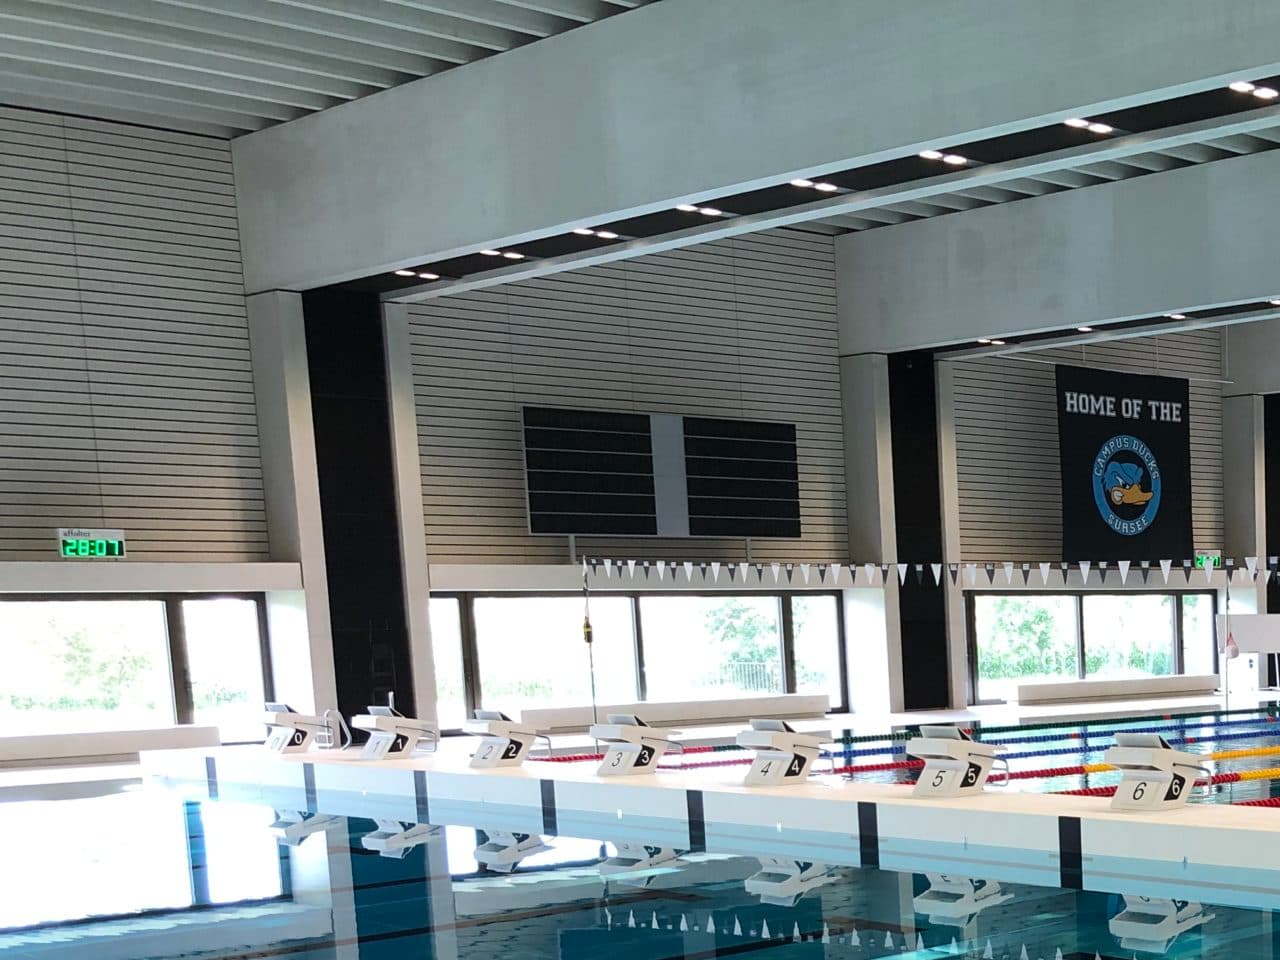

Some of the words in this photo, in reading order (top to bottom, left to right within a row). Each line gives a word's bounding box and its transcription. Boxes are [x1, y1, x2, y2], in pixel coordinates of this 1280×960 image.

[1065, 391, 1116, 417] HOME
[1121, 398, 1143, 419] OF
[1148, 401, 1182, 422] THE
[1094, 437, 1130, 477] CAMPUS
[1131, 439, 1160, 480] DUCKS
[1107, 514, 1148, 534] SURSEE
[65, 539, 119, 556] 28:07
[294, 732, 303, 745] 0
[397, 738, 404, 749] 1
[481, 745, 494, 760] 2
[507, 744, 517, 757] 2
[641, 750, 650, 764] 3
[611, 752, 623, 767] 3
[791, 759, 800, 773] 4
[760, 760, 772, 777] 4
[967, 768, 976, 783] 5
[932, 770, 946, 787] 5
[1171, 778, 1180, 795] 6
[1132, 781, 1147, 800] 6
